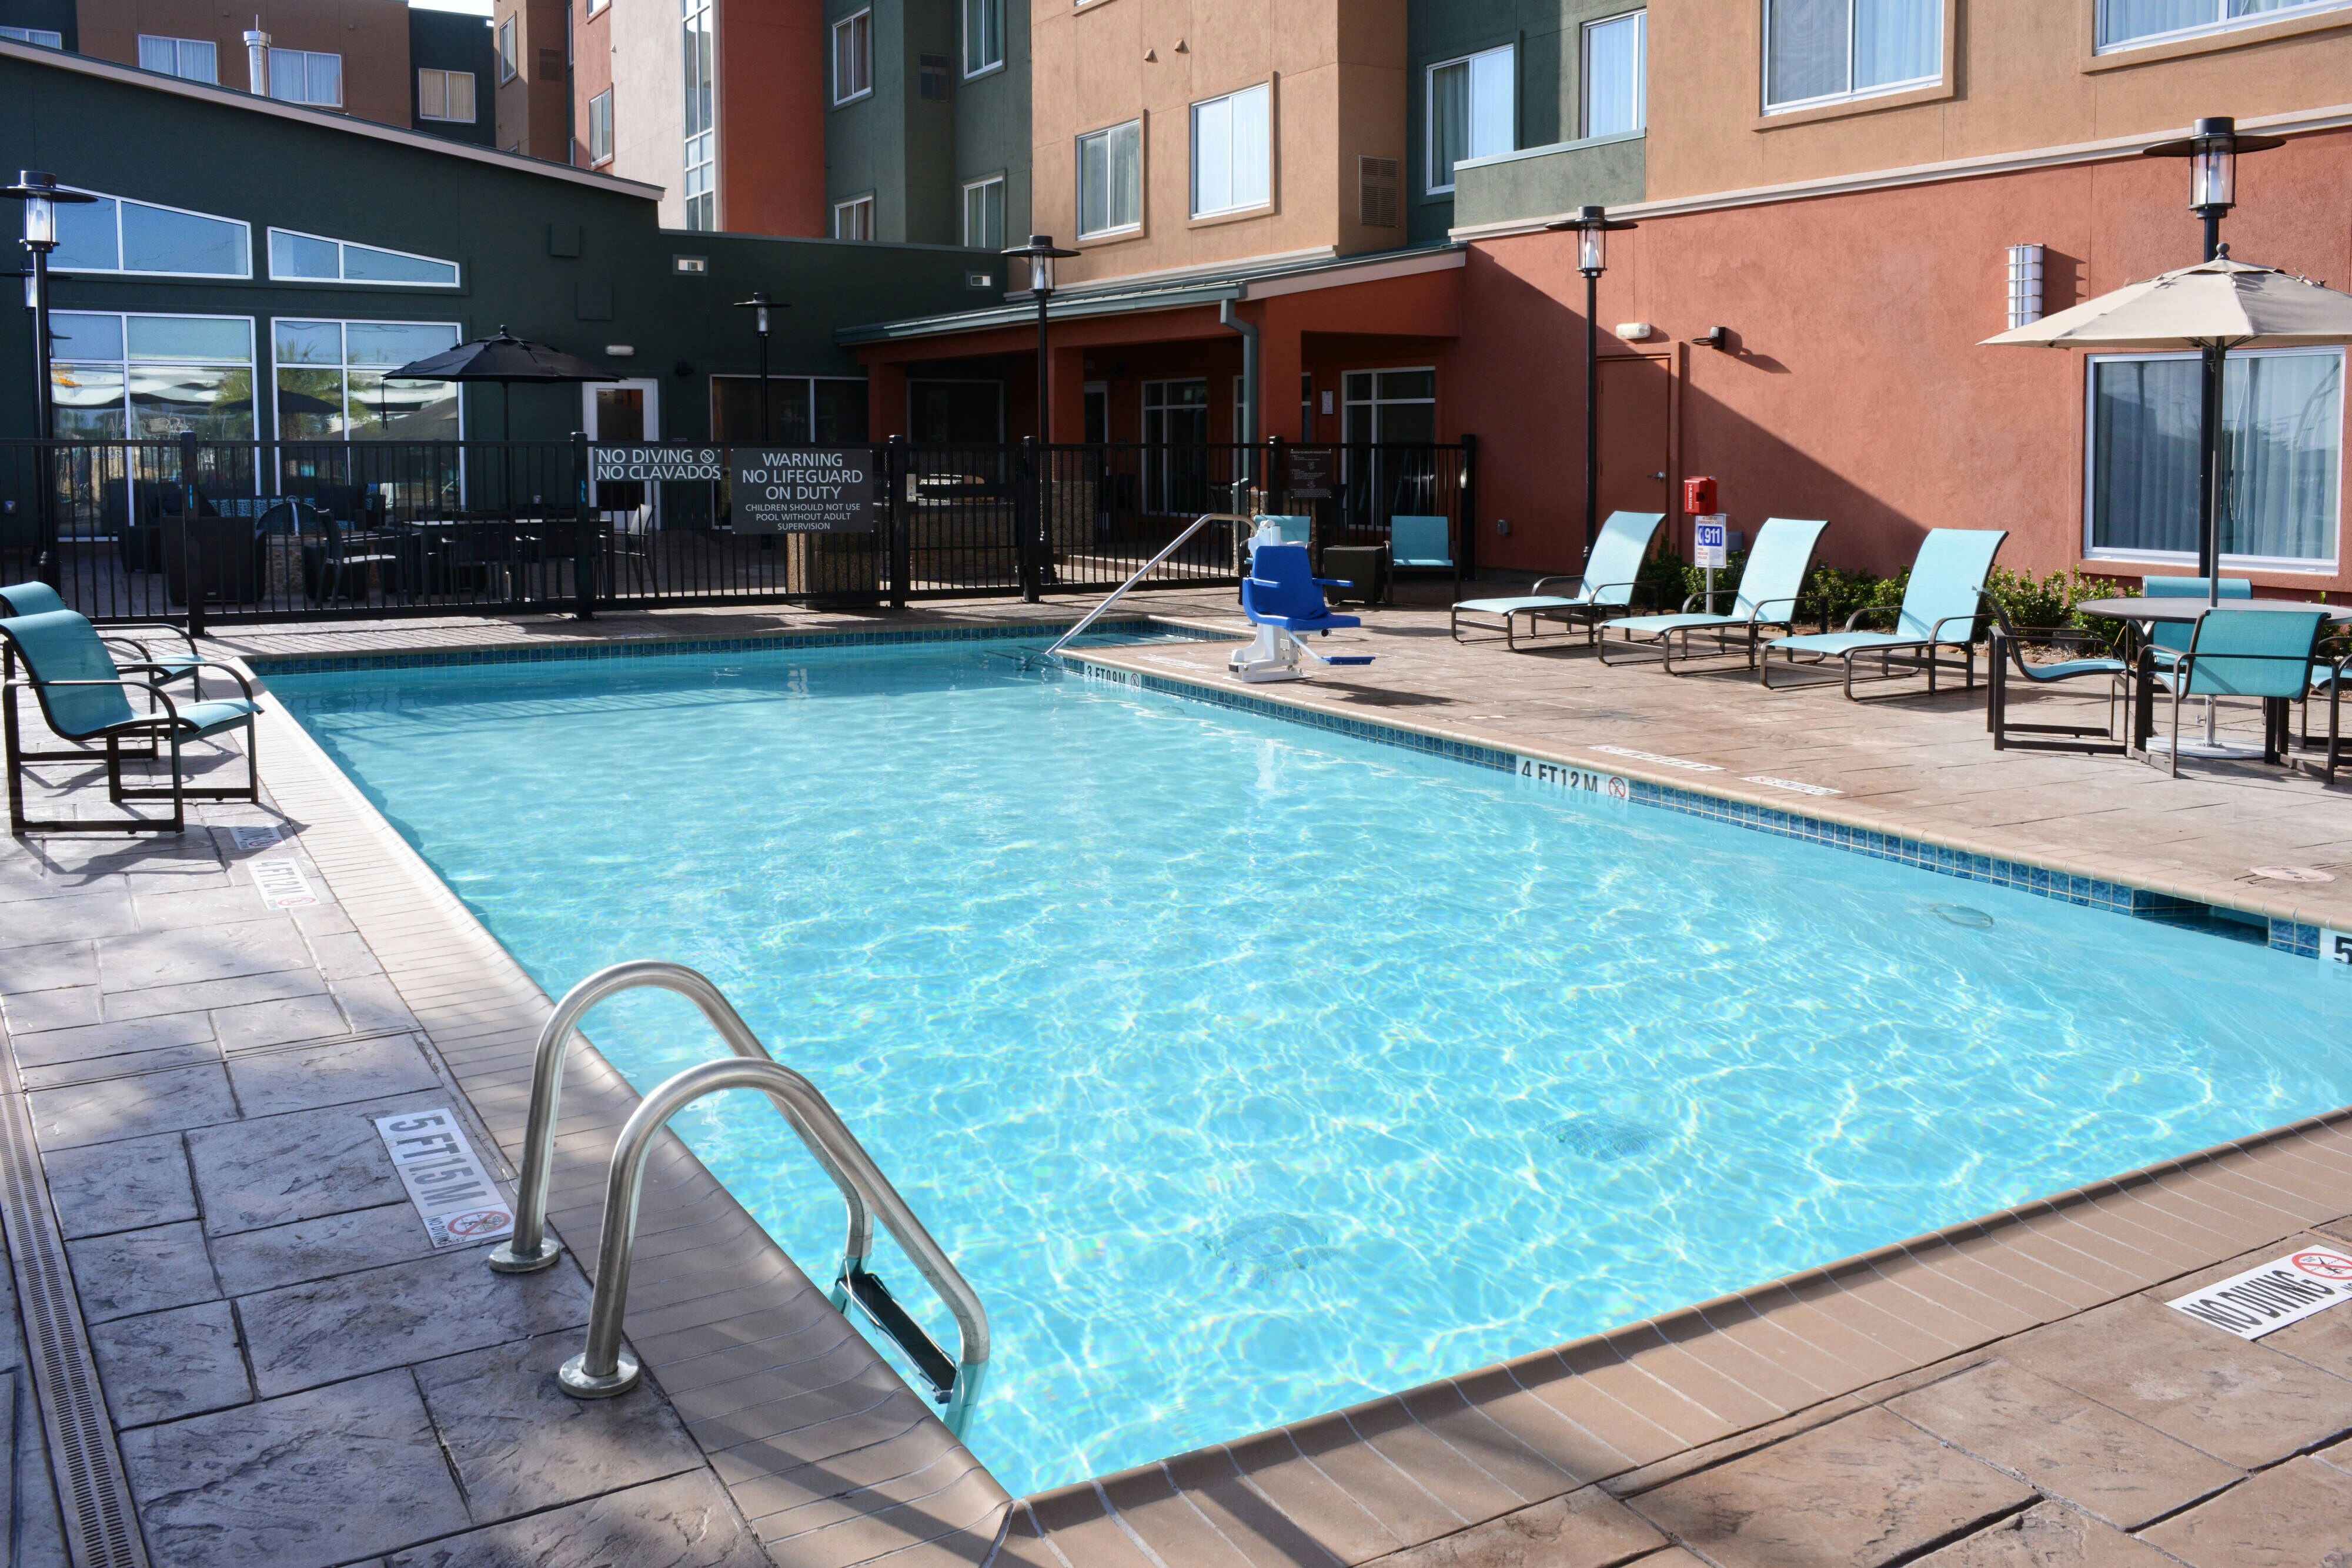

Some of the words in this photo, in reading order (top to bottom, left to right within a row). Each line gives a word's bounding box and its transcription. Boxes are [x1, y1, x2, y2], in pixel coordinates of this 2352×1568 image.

[599, 449, 626, 463] NO
[633, 449, 693, 463] DIVING
[763, 453, 843, 466] WARNING
[598, 466, 624, 479] NO
[629, 466, 720, 479] CLAVADOS
[743, 470, 767, 483] NO
[774, 470, 863, 483] LIFEGUARD
[766, 486, 790, 500] ON
[797, 486, 841, 499] DUTY
[1705, 528, 1720, 544] 911
[1522, 761, 1532, 777] 4
[389, 1115, 446, 1132] 5
[396, 1132, 461, 1159] FT
[2216, 1270, 2336, 1319] DIVING
[2181, 1299, 2263, 1333] NO
